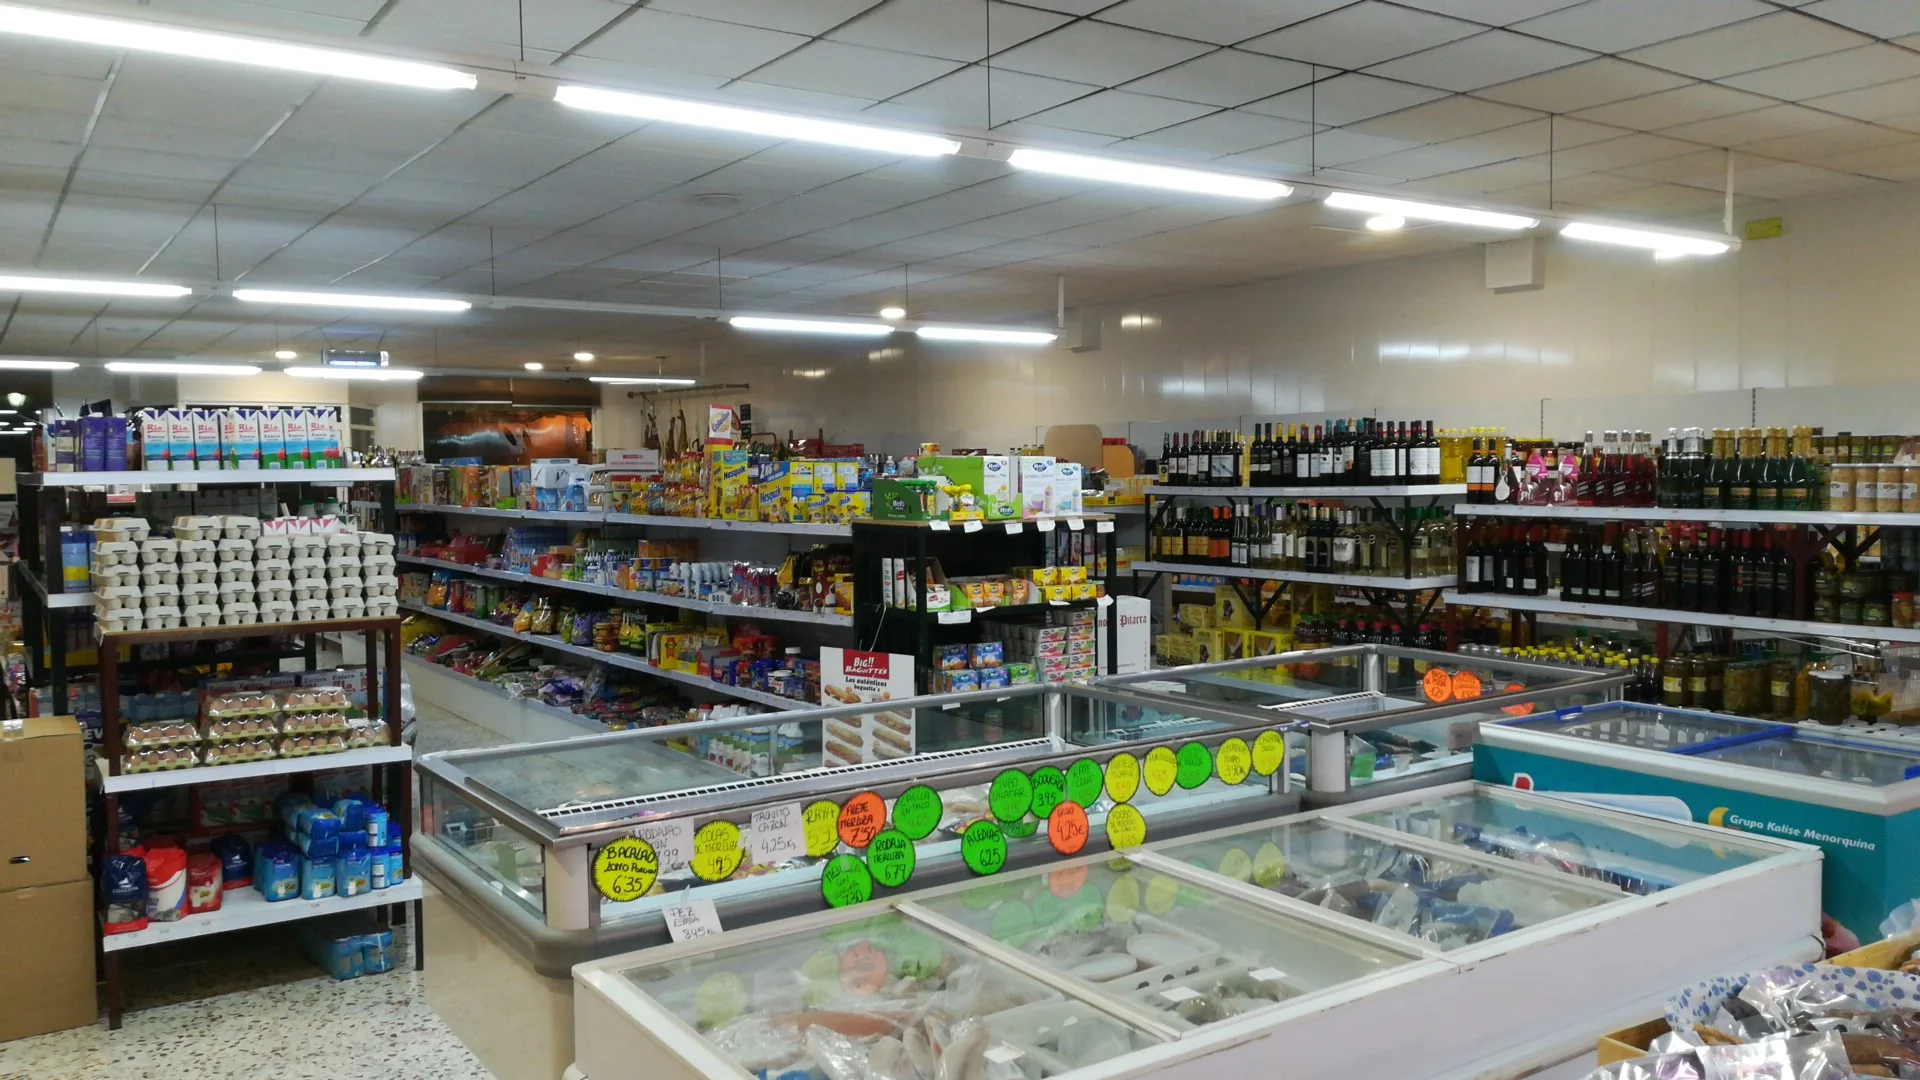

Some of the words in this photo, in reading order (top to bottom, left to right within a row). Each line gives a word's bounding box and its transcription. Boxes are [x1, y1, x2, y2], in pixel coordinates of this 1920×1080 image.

[724, 465, 746, 480] Nesquik
[760, 486, 782, 504] Nesquik
[1120, 614, 1146, 628] Pitarra
[846, 676, 855, 684] Los
[856, 678, 886, 687] auténticos
[1730, 814, 1764, 829] Grupo
[1767, 822, 1801, 836] Kalise
[1804, 829, 1876, 850] Menorquina
[606, 846, 656, 863] BACALAO
[670, 906, 695, 918] PEZ
